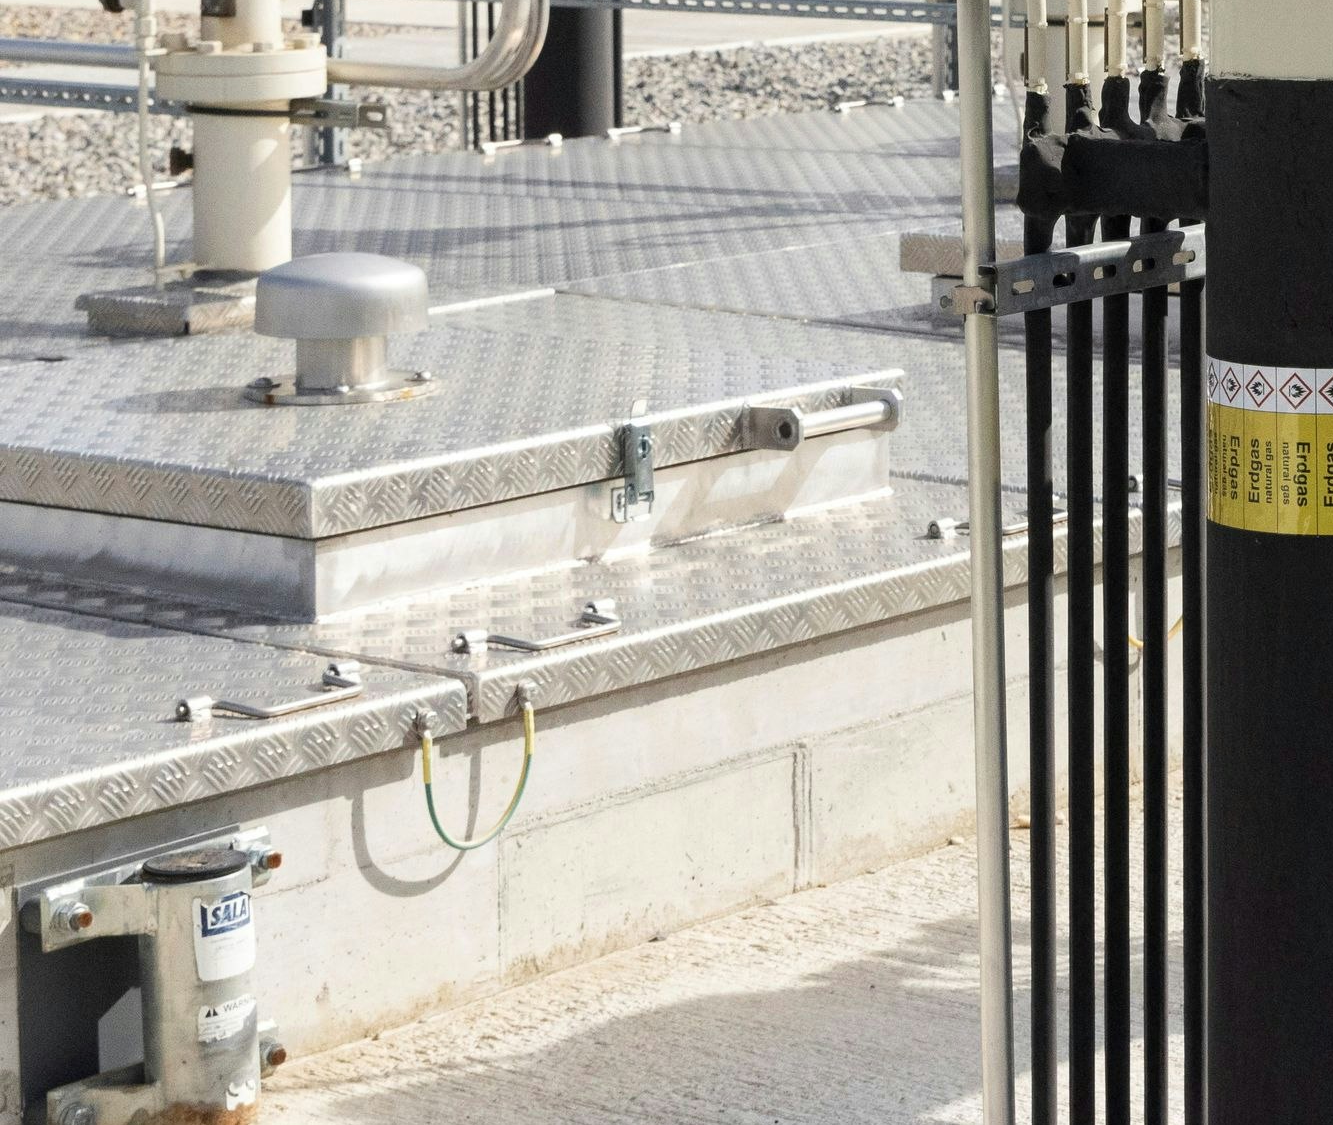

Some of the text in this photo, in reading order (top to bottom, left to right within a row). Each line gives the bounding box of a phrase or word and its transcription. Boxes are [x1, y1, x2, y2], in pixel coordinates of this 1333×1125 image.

[1229, 436, 1240, 500] Erdgas
[1248, 438, 1262, 503] Erdgas
[1264, 441, 1273, 504] natural gas
[1281, 442, 1291, 505] natural gas
[1293, 442, 1311, 507] Erdgas
[210, 898, 248, 926] SALA
